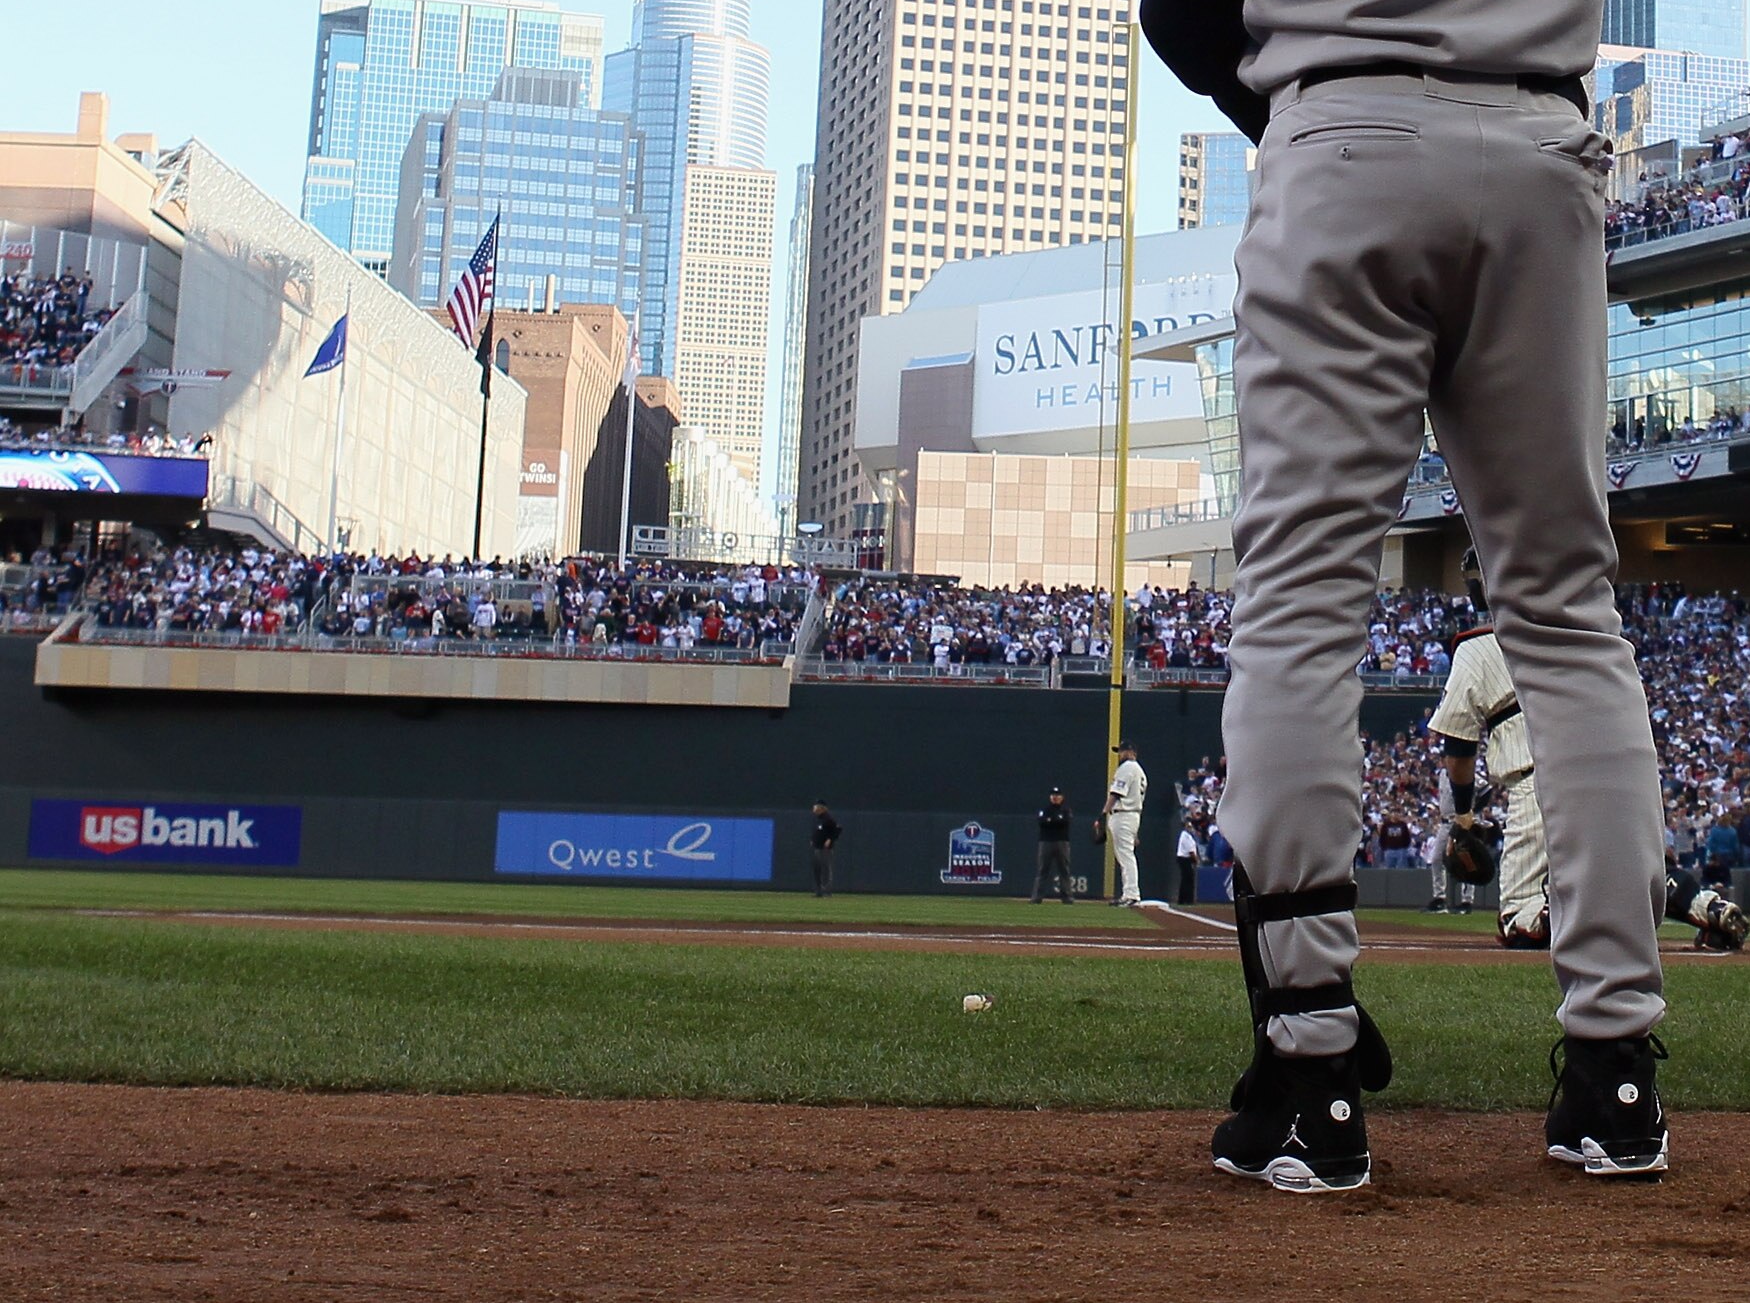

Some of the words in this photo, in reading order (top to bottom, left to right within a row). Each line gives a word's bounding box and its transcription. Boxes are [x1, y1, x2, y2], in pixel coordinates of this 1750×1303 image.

[1036, 375, 1172, 409] HEALTH
[529, 462, 546, 474] GO
[549, 839, 655, 871] Qwest
[952, 859, 991, 867] SEASON
